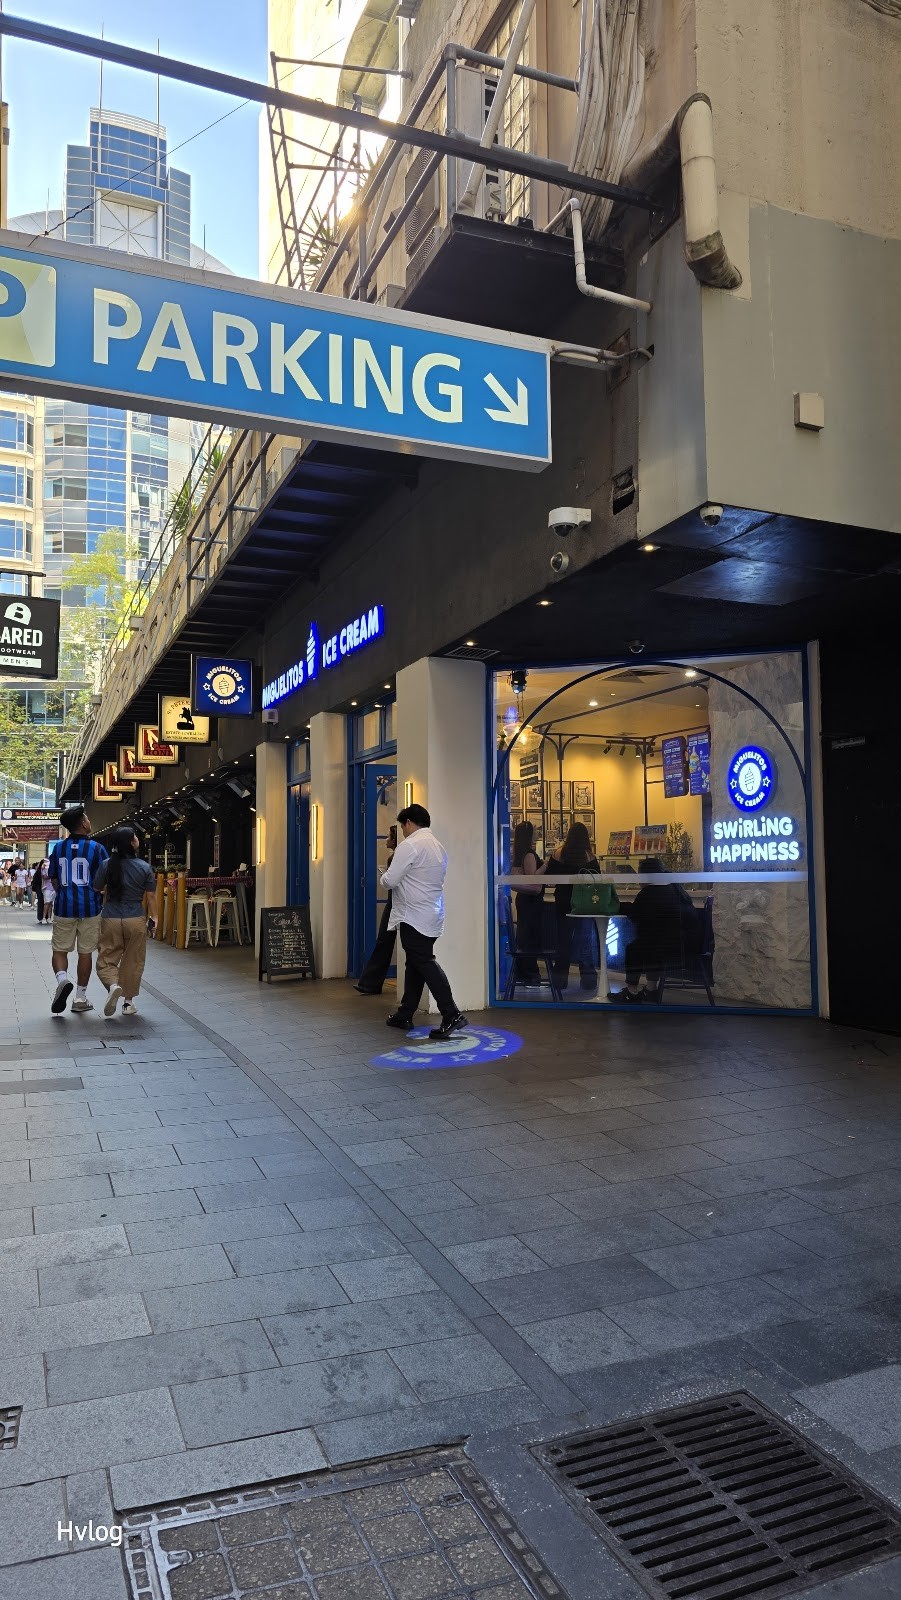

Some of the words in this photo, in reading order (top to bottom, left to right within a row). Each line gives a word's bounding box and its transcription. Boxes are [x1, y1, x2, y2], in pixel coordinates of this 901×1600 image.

[93, 287, 463, 423] PARKING
[0, 626, 43, 647] ARED
[0, 648, 36, 656] OOTWEAR
[262, 660, 304, 709] MIGUELITOS
[322, 635, 337, 668] ICE
[340, 605, 379, 655] CREAM
[205, 665, 243, 682] MIGUELITOS
[207, 692, 219, 703] ICE
[219, 694, 240, 705] CREAM
[733, 751, 768, 774] MIGUELITOS
[734, 792, 745, 805] ICE
[744, 791, 766, 807] CREAM
[58, 857, 90, 887] 10
